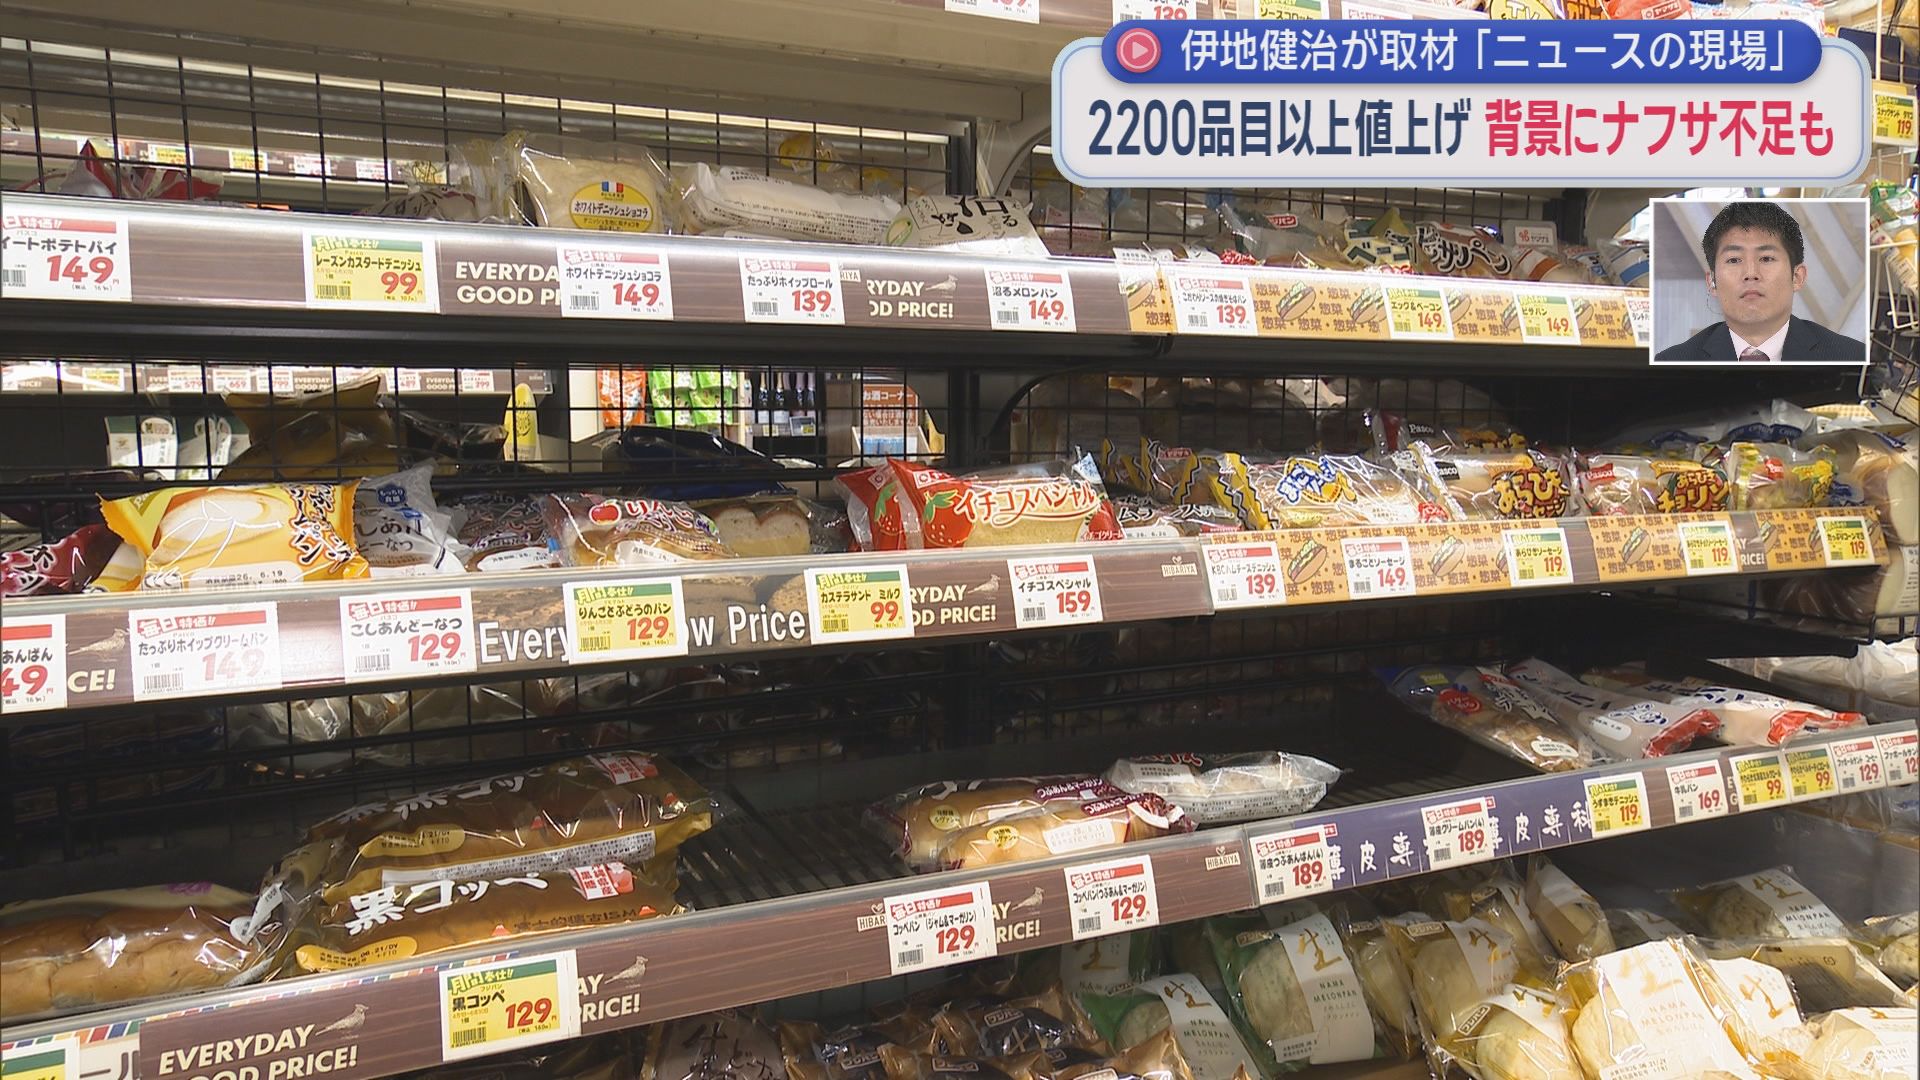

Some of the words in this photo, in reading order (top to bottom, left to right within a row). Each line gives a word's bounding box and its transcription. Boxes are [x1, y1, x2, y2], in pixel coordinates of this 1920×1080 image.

[1897, 119, 1912, 135] 119
[574, 200, 649, 219] ホワイトデニッシュショコラ
[2, 215, 63, 230] 日特価!!
[47, 254, 114, 285] 149
[316, 255, 422, 272] レーズンカスタードデニッシュ
[381, 271, 418, 295] 99
[566, 267, 662, 282] ホワイトデニッシュショコラ
[747, 275, 833, 289] たっぷりホイップロール
[456, 285, 534, 306] GOOD
[613, 284, 660, 306] 149
[791, 290, 832, 312] 139
[898, 302, 954, 318] PRICE!
[1028, 300, 1064, 320] 149
[1216, 305, 1247, 324] 139
[1418, 312, 1442, 329] 149
[1547, 317, 1569, 332] 149
[1408, 423, 1434, 434] Pasco
[1587, 469, 1613, 480] Pasco
[953, 480, 1101, 522] イチゴスペシャル
[1712, 547, 1728, 562] 119
[1849, 541, 1865, 554] 119
[1349, 557, 1405, 568] まるごとソーセージ
[1543, 557, 1562, 573] 119
[1741, 552, 1765, 565] RICE!
[1162, 563, 1198, 576] HIBARIYA
[1377, 567, 1406, 588] 149
[1018, 579, 1091, 594] イチゴスペシャル
[1245, 574, 1276, 594] 139
[821, 589, 872, 604] カステラサンド
[879, 588, 901, 600] ミルク
[1056, 590, 1091, 614] 159
[349, 601, 417, 621] 毎日特価!!
[579, 603, 672, 620] りんごとぶどうのパン
[870, 600, 899, 623] 99
[940, 604, 996, 624] PRICE!
[138, 616, 216, 638] 毎日特価!!
[351, 618, 463, 637] こしあんどーなつ
[479, 621, 568, 665] Every
[727, 603, 806, 645] Price
[627, 616, 669, 641] 129
[138, 633, 268, 656] たっぷりホイップクリームパン
[408, 632, 461, 662] 129
[202, 650, 265, 681] 149
[67, 669, 115, 692] CE!
[1815, 771, 1830, 787] 99
[1859, 763, 1879, 782] 129
[1674, 783, 1698, 795] 牛乳パン
[1767, 779, 1781, 795] 99
[1592, 794, 1639, 809] うずまきデニッシュ
[1698, 792, 1720, 809] 169
[1620, 804, 1638, 822] 119
[1458, 829, 1485, 853] 189
[1207, 855, 1240, 869] HIBARIYA
[1292, 861, 1324, 886] 189
[345, 872, 549, 936] 黒コッペ
[1111, 894, 1146, 922] 129
[892, 921, 921, 936] コッペパン
[996, 919, 1041, 944] RICE!
[936, 925, 976, 955] 129
[451, 968, 514, 995] 月間奉仕!!
[1319, 980, 1345, 989] NAMA
[452, 990, 505, 1012] 黒コッペ
[1313, 989, 1358, 1002] MELONPAN
[505, 998, 552, 1029] 129
[580, 993, 640, 1024] RICE!
[159, 1024, 315, 1076] EVERYDAY
[268, 1046, 358, 1080] PRICE!
